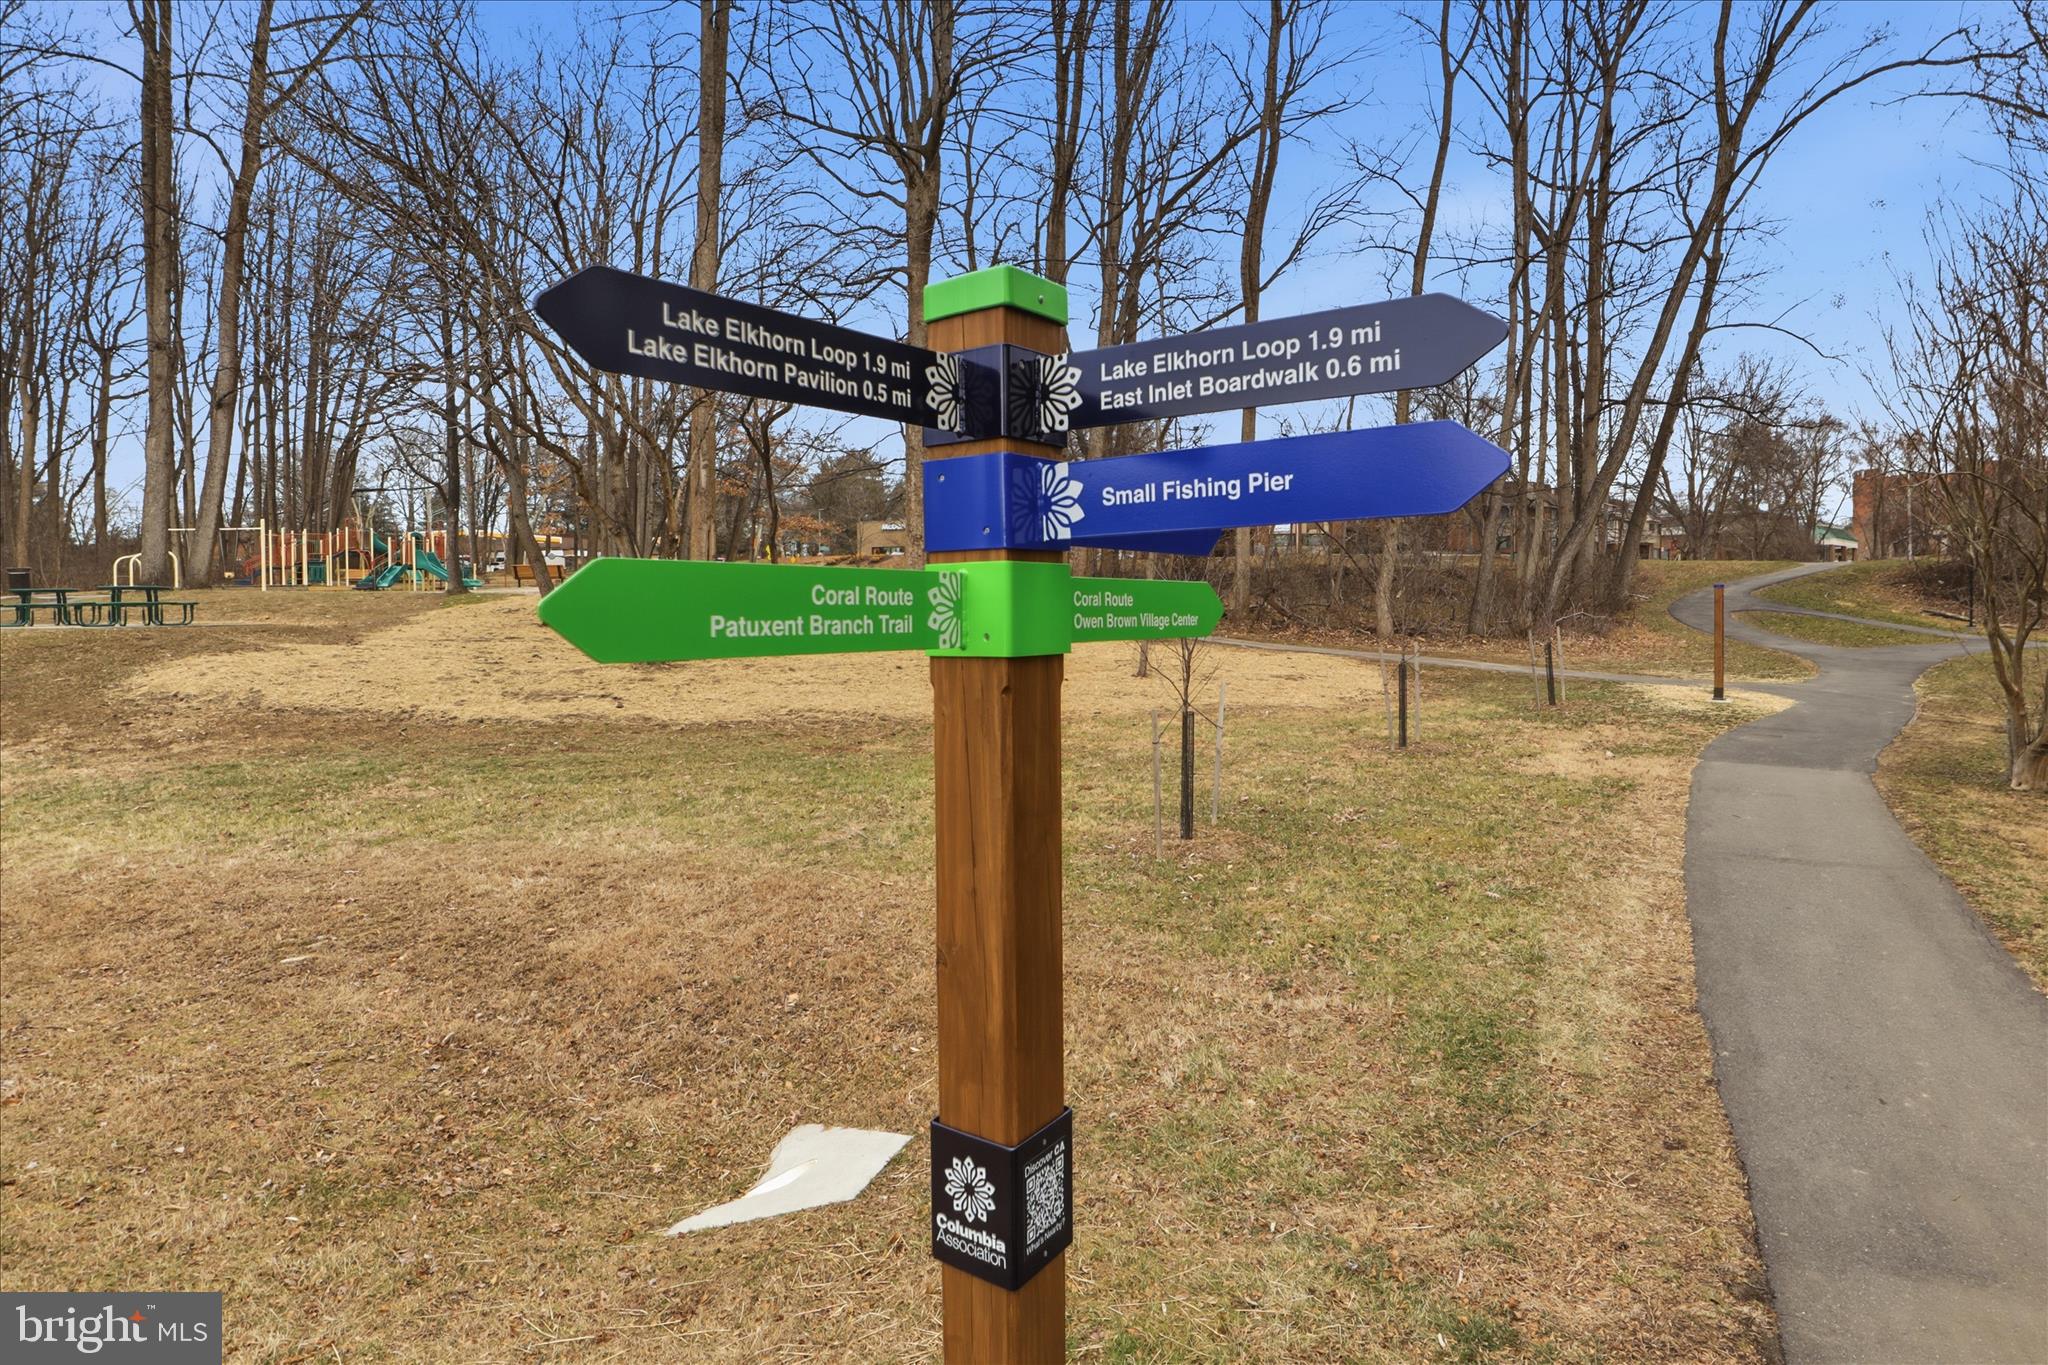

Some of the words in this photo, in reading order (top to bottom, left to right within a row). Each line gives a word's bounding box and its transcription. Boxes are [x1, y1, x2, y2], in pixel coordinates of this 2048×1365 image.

[662, 302, 720, 337] Lake
[725, 319, 805, 357] Elkhorn
[811, 338, 857, 369] Loop
[863, 351, 887, 374] 1.9
[891, 360, 911, 380] mi
[1101, 359, 1147, 382] Lake
[1153, 346, 1235, 373] Elkhorn
[1242, 336, 1301, 362] Loop
[1308, 327, 1343, 351] 1.9
[1351, 320, 1381, 345] mi
[627, 329, 688, 364] Lake
[694, 343, 778, 382] Elkhorn
[785, 364, 858, 398] Pavilion
[863, 380, 888, 401] 0.5
[892, 388, 912, 408] mi
[1100, 389, 1143, 410] East
[1149, 379, 1192, 403] Inlet
[1200, 362, 1318, 397] Boardwalk
[1325, 355, 1362, 379] 0.6
[1370, 348, 1400, 373] mi
[1102, 483, 1156, 506] Small
[1163, 478, 1240, 500] Fishing
[1248, 472, 1294, 493] Pier
[811, 584, 860, 606] Coral
[866, 586, 913, 606] Route
[1073, 591, 1101, 607] Coral
[1104, 592, 1133, 607] Route
[710, 615, 804, 638] Patuxent
[810, 615, 873, 636] Branch
[879, 615, 913, 634] Trail
[1073, 613, 1103, 629] Owen
[1106, 613, 1137, 628] Brown
[1140, 613, 1170, 630] Village
[1171, 613, 1199, 627] Center
[1024, 1150, 1053, 1178] Discover
[1054, 1141, 1066, 1155] CA
[936, 1212, 1006, 1254] Columbia
[936, 1228, 1007, 1270] Association
